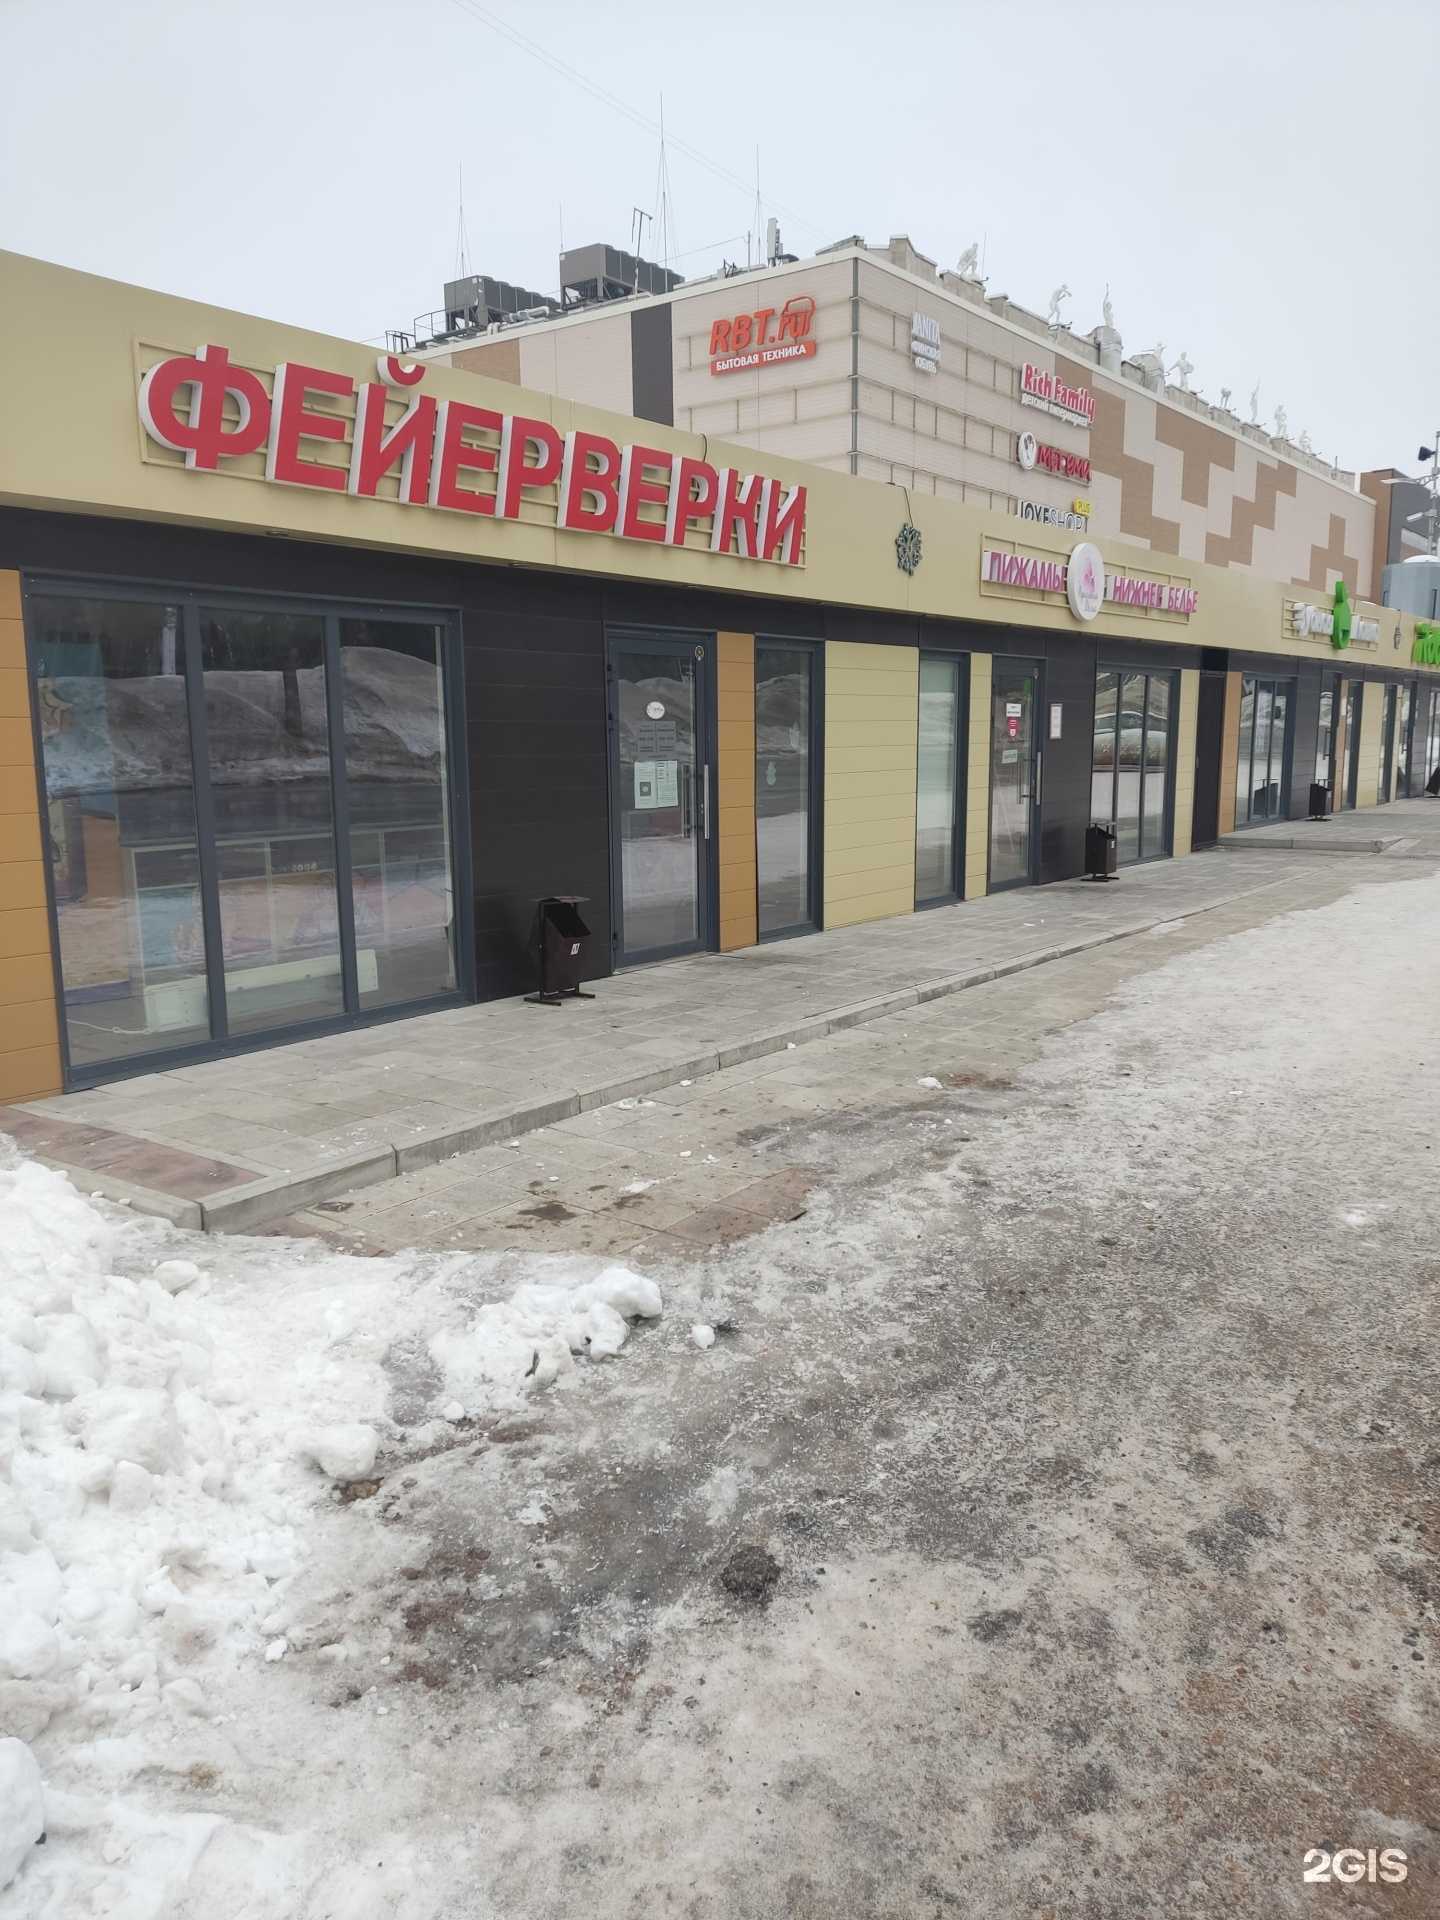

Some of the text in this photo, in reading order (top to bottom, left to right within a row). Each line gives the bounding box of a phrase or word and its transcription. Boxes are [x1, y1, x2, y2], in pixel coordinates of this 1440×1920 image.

[716, 344, 806, 371] БЫТОВАЯ ТЕХНИКА
[1023, 363, 1095, 423] Rich Family
[138, 345, 807, 566] ФЕЙЕРВЕРКИ
[988, 551, 1067, 592] ПИЖАМЫ
